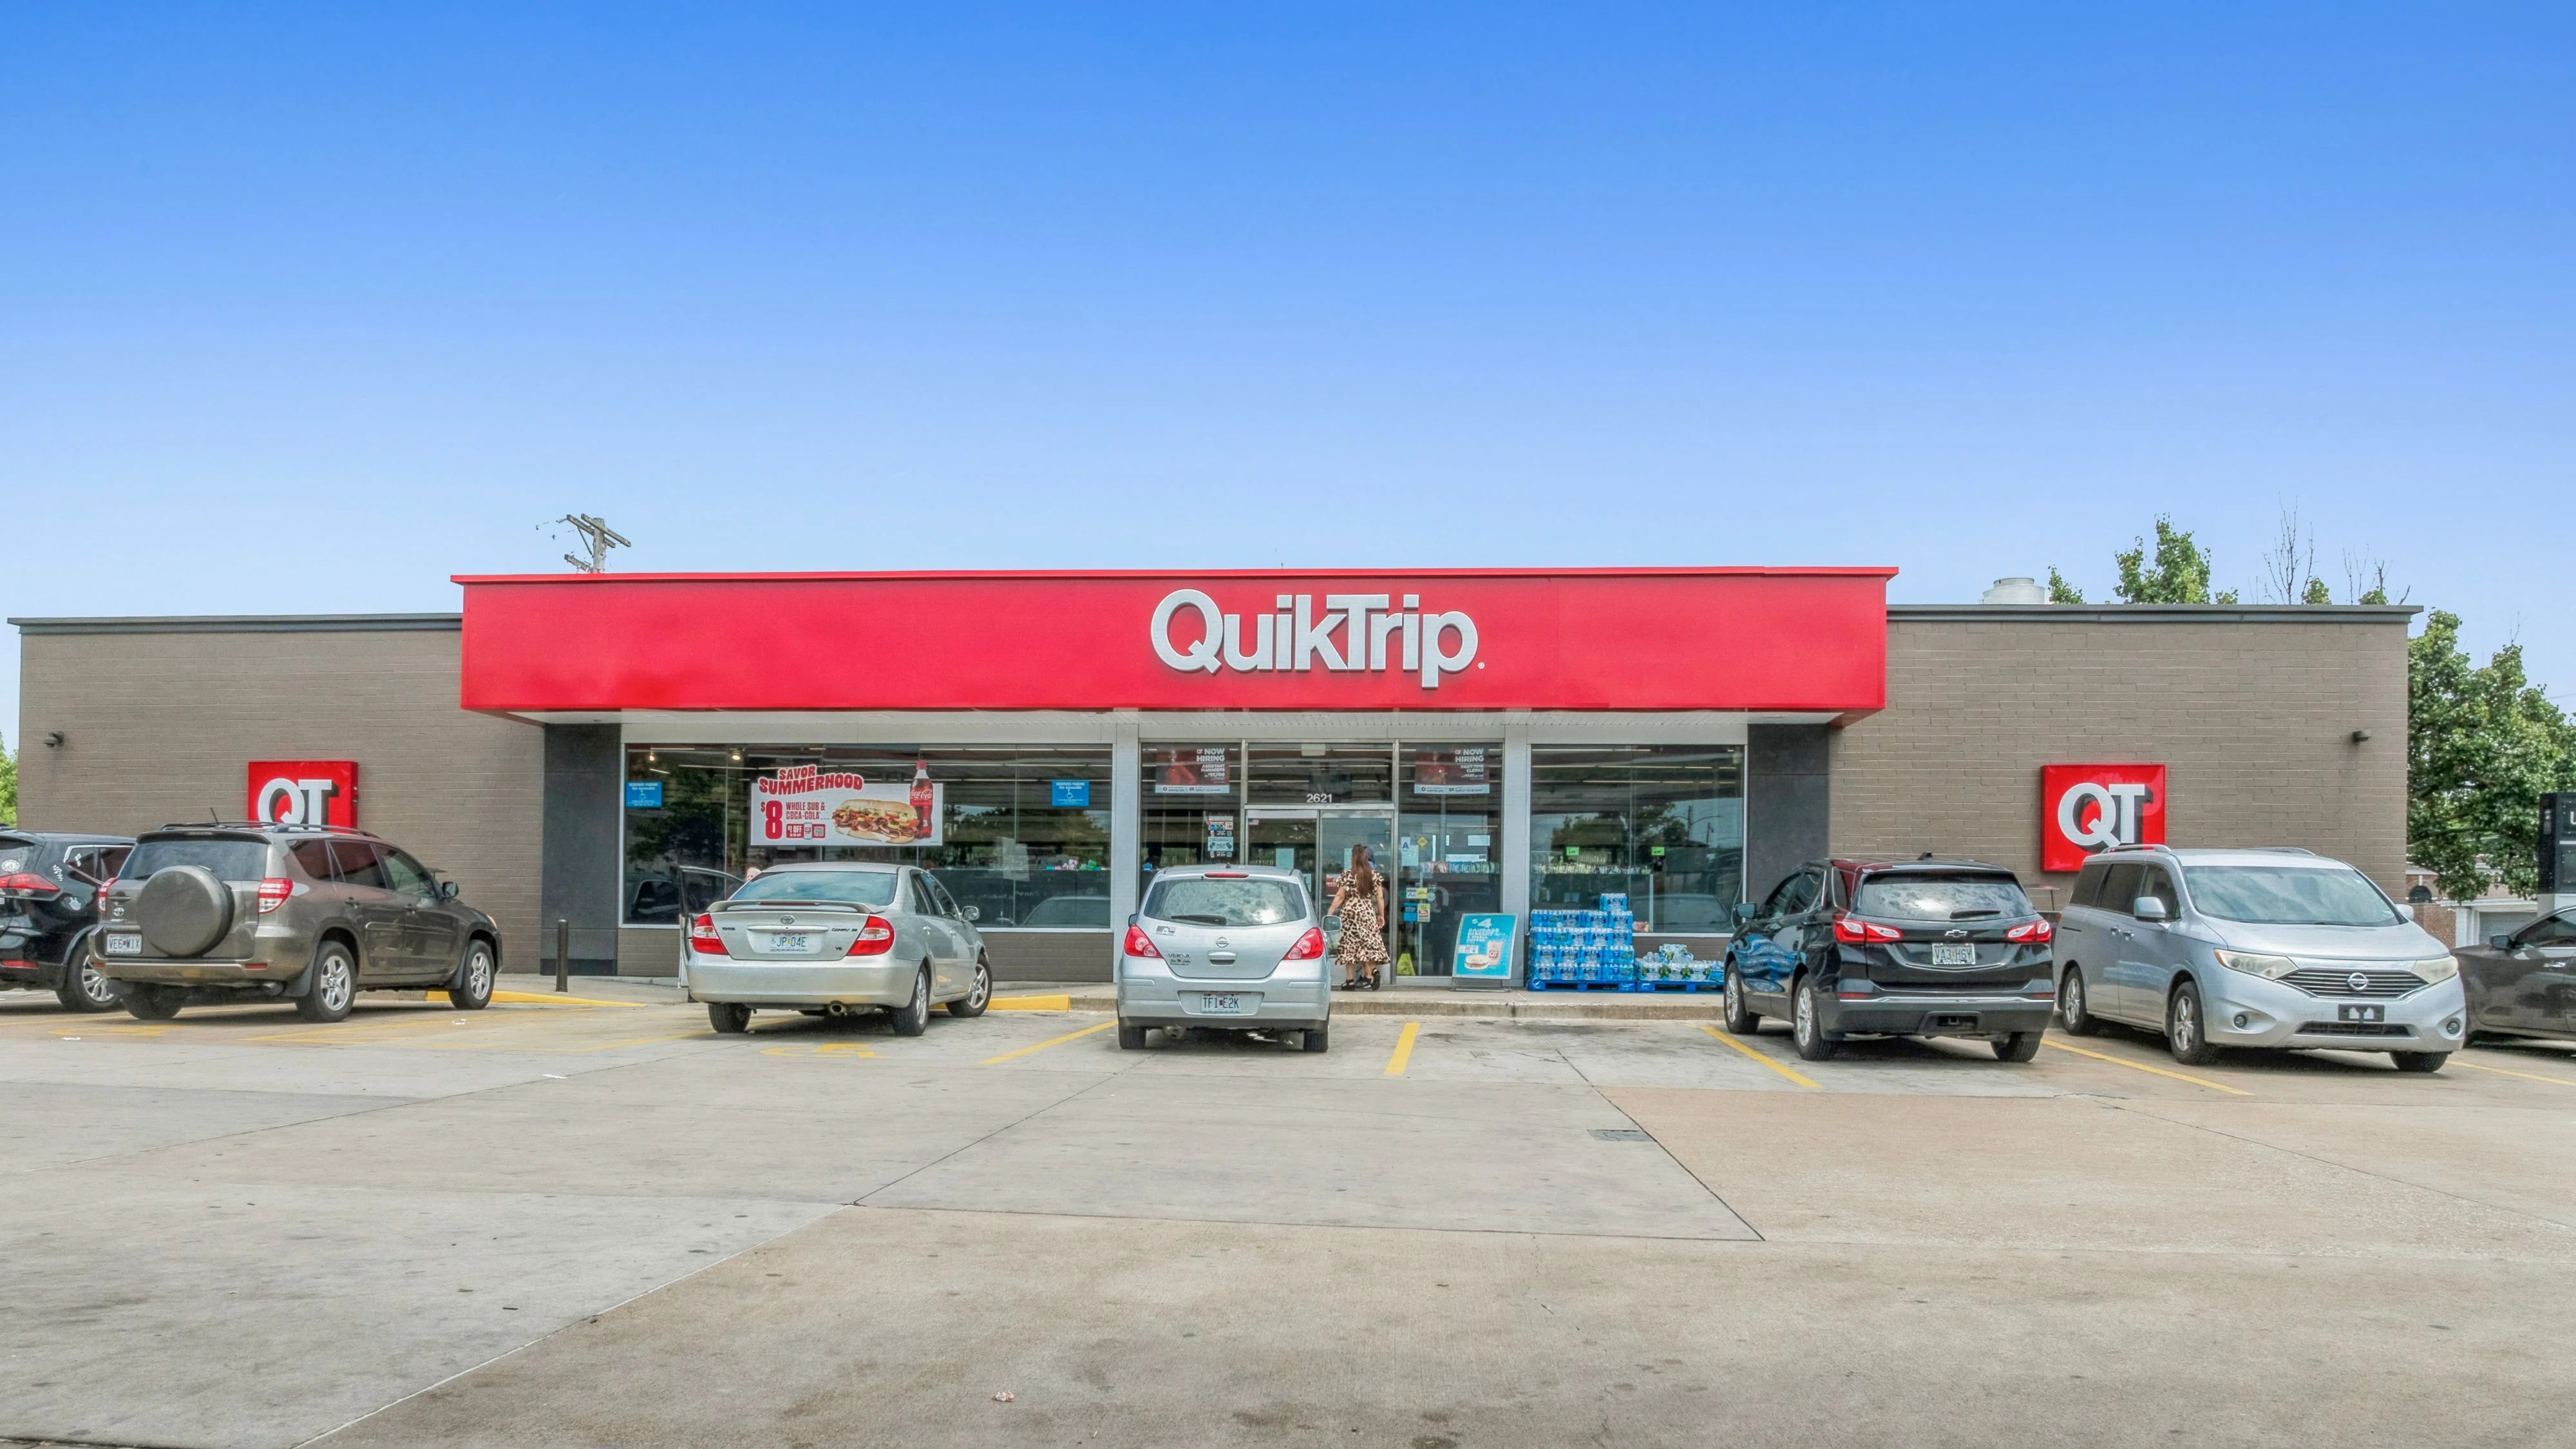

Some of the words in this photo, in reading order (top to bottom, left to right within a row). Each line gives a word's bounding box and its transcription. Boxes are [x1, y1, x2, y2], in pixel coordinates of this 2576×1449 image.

[1150, 589, 1479, 689] QuikTrip
[779, 766, 816, 780] SAVOR
[759, 774, 863, 795] SUMMERHOOD
[258, 778, 332, 831] QT
[786, 802, 806, 810] WHOLE
[808, 802, 819, 810] SUB
[820, 802, 825, 810] &
[1307, 793, 1332, 803] 2621
[2058, 782, 2145, 848] QT
